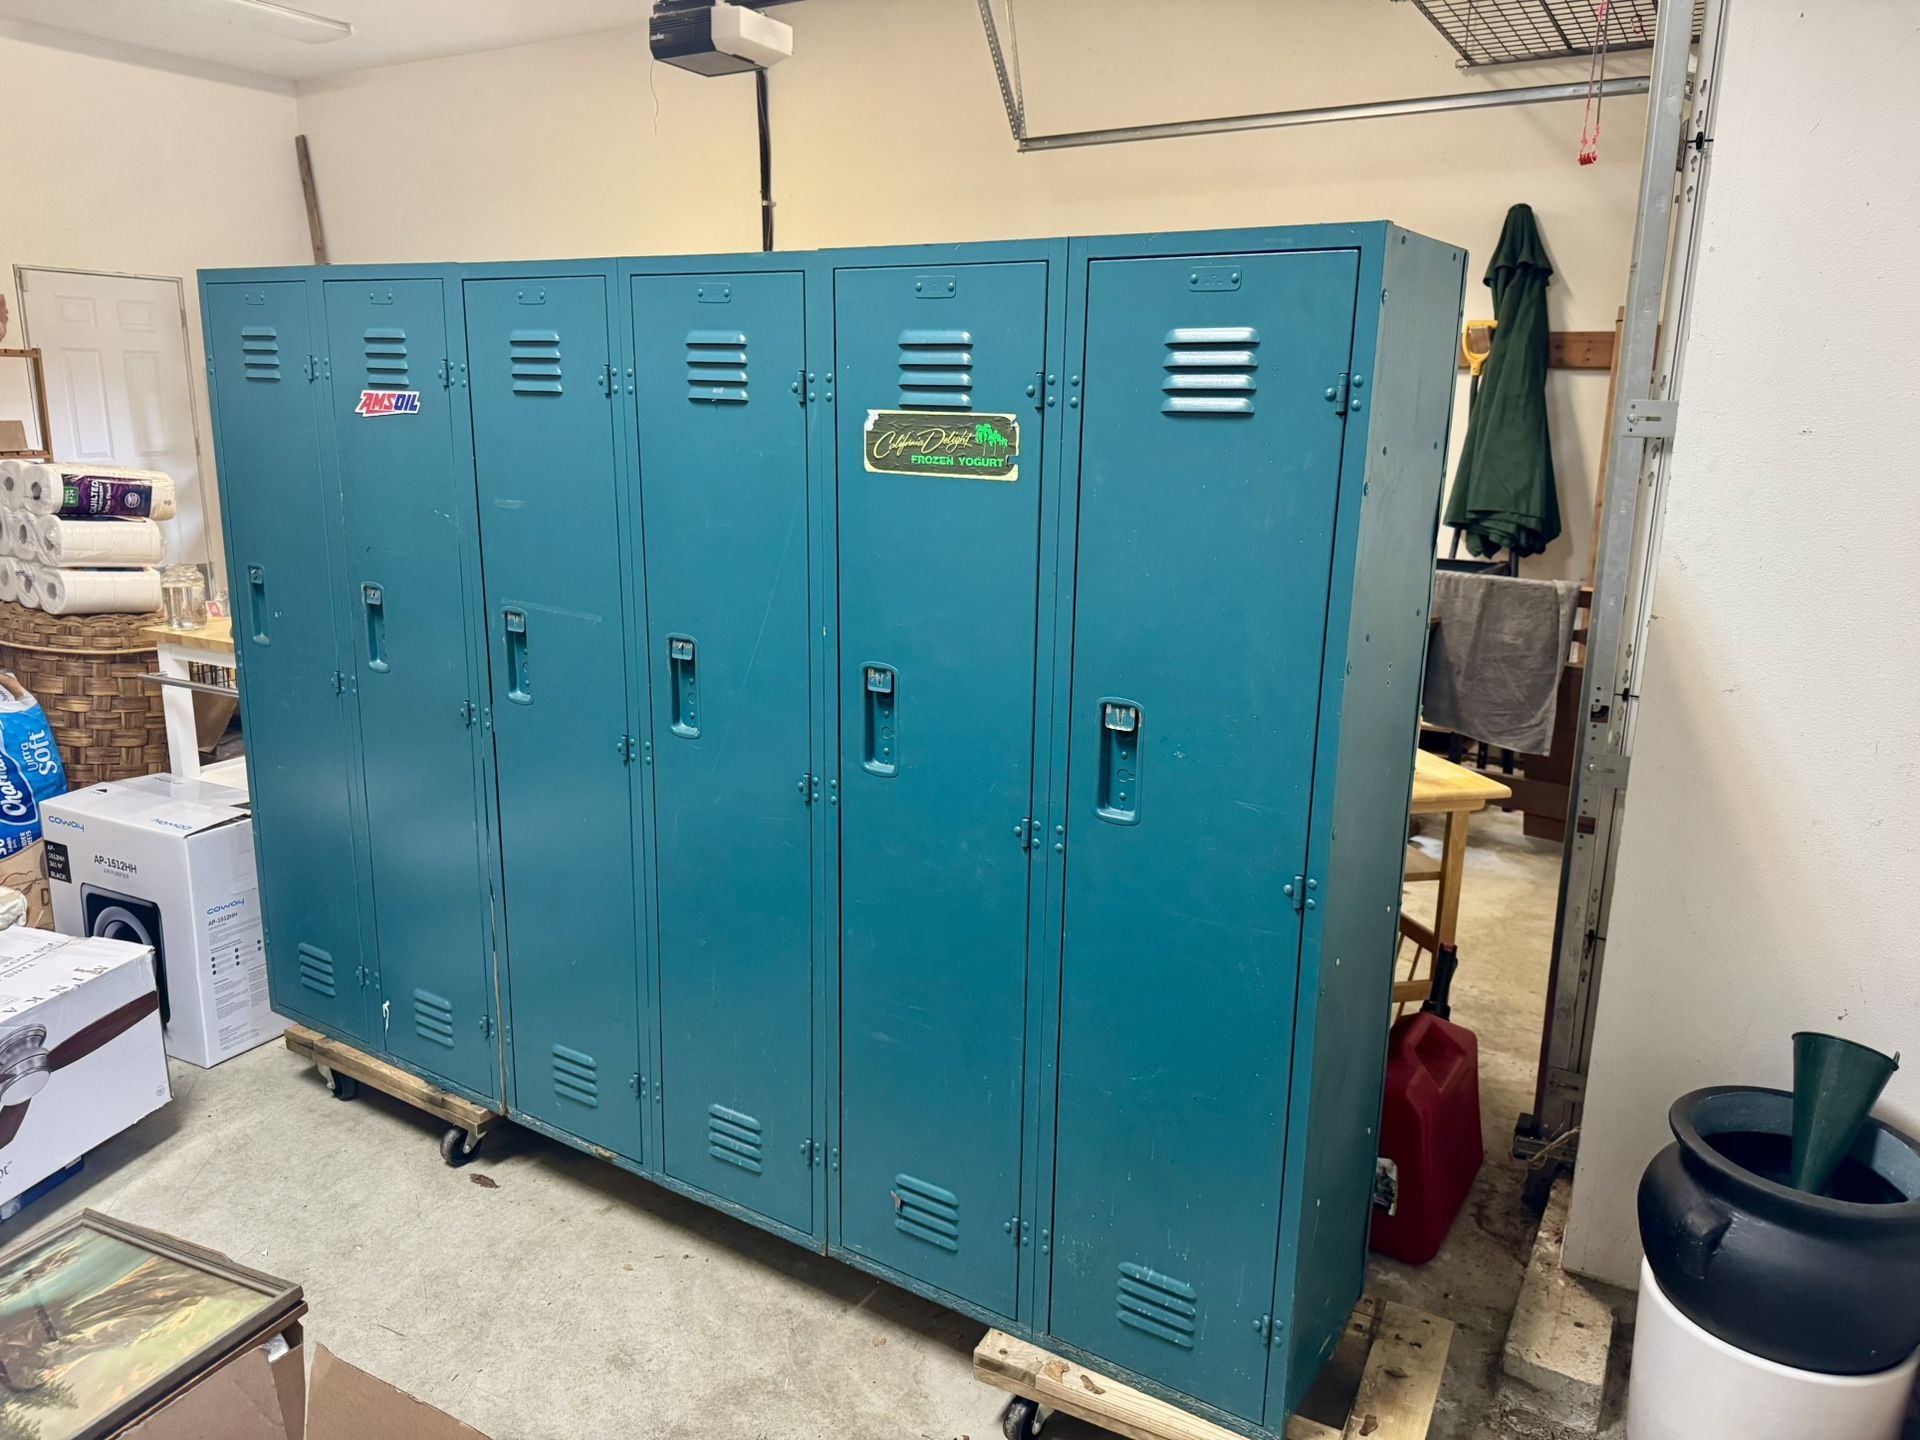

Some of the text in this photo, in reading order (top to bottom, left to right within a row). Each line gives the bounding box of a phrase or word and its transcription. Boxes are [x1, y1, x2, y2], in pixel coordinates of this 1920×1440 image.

[358, 392, 418, 414] AMSOIL
[873, 428, 972, 458] California Delight
[911, 455, 1004, 467] FROZEN YOGURT
[89, 480, 99, 514] QUILTED
[21, 741, 38, 772] Ultra
[28, 729, 58, 775] Soft
[48, 815, 85, 832] coway
[94, 854, 137, 875] AP-1512HH
[207, 898, 245, 914] coway
